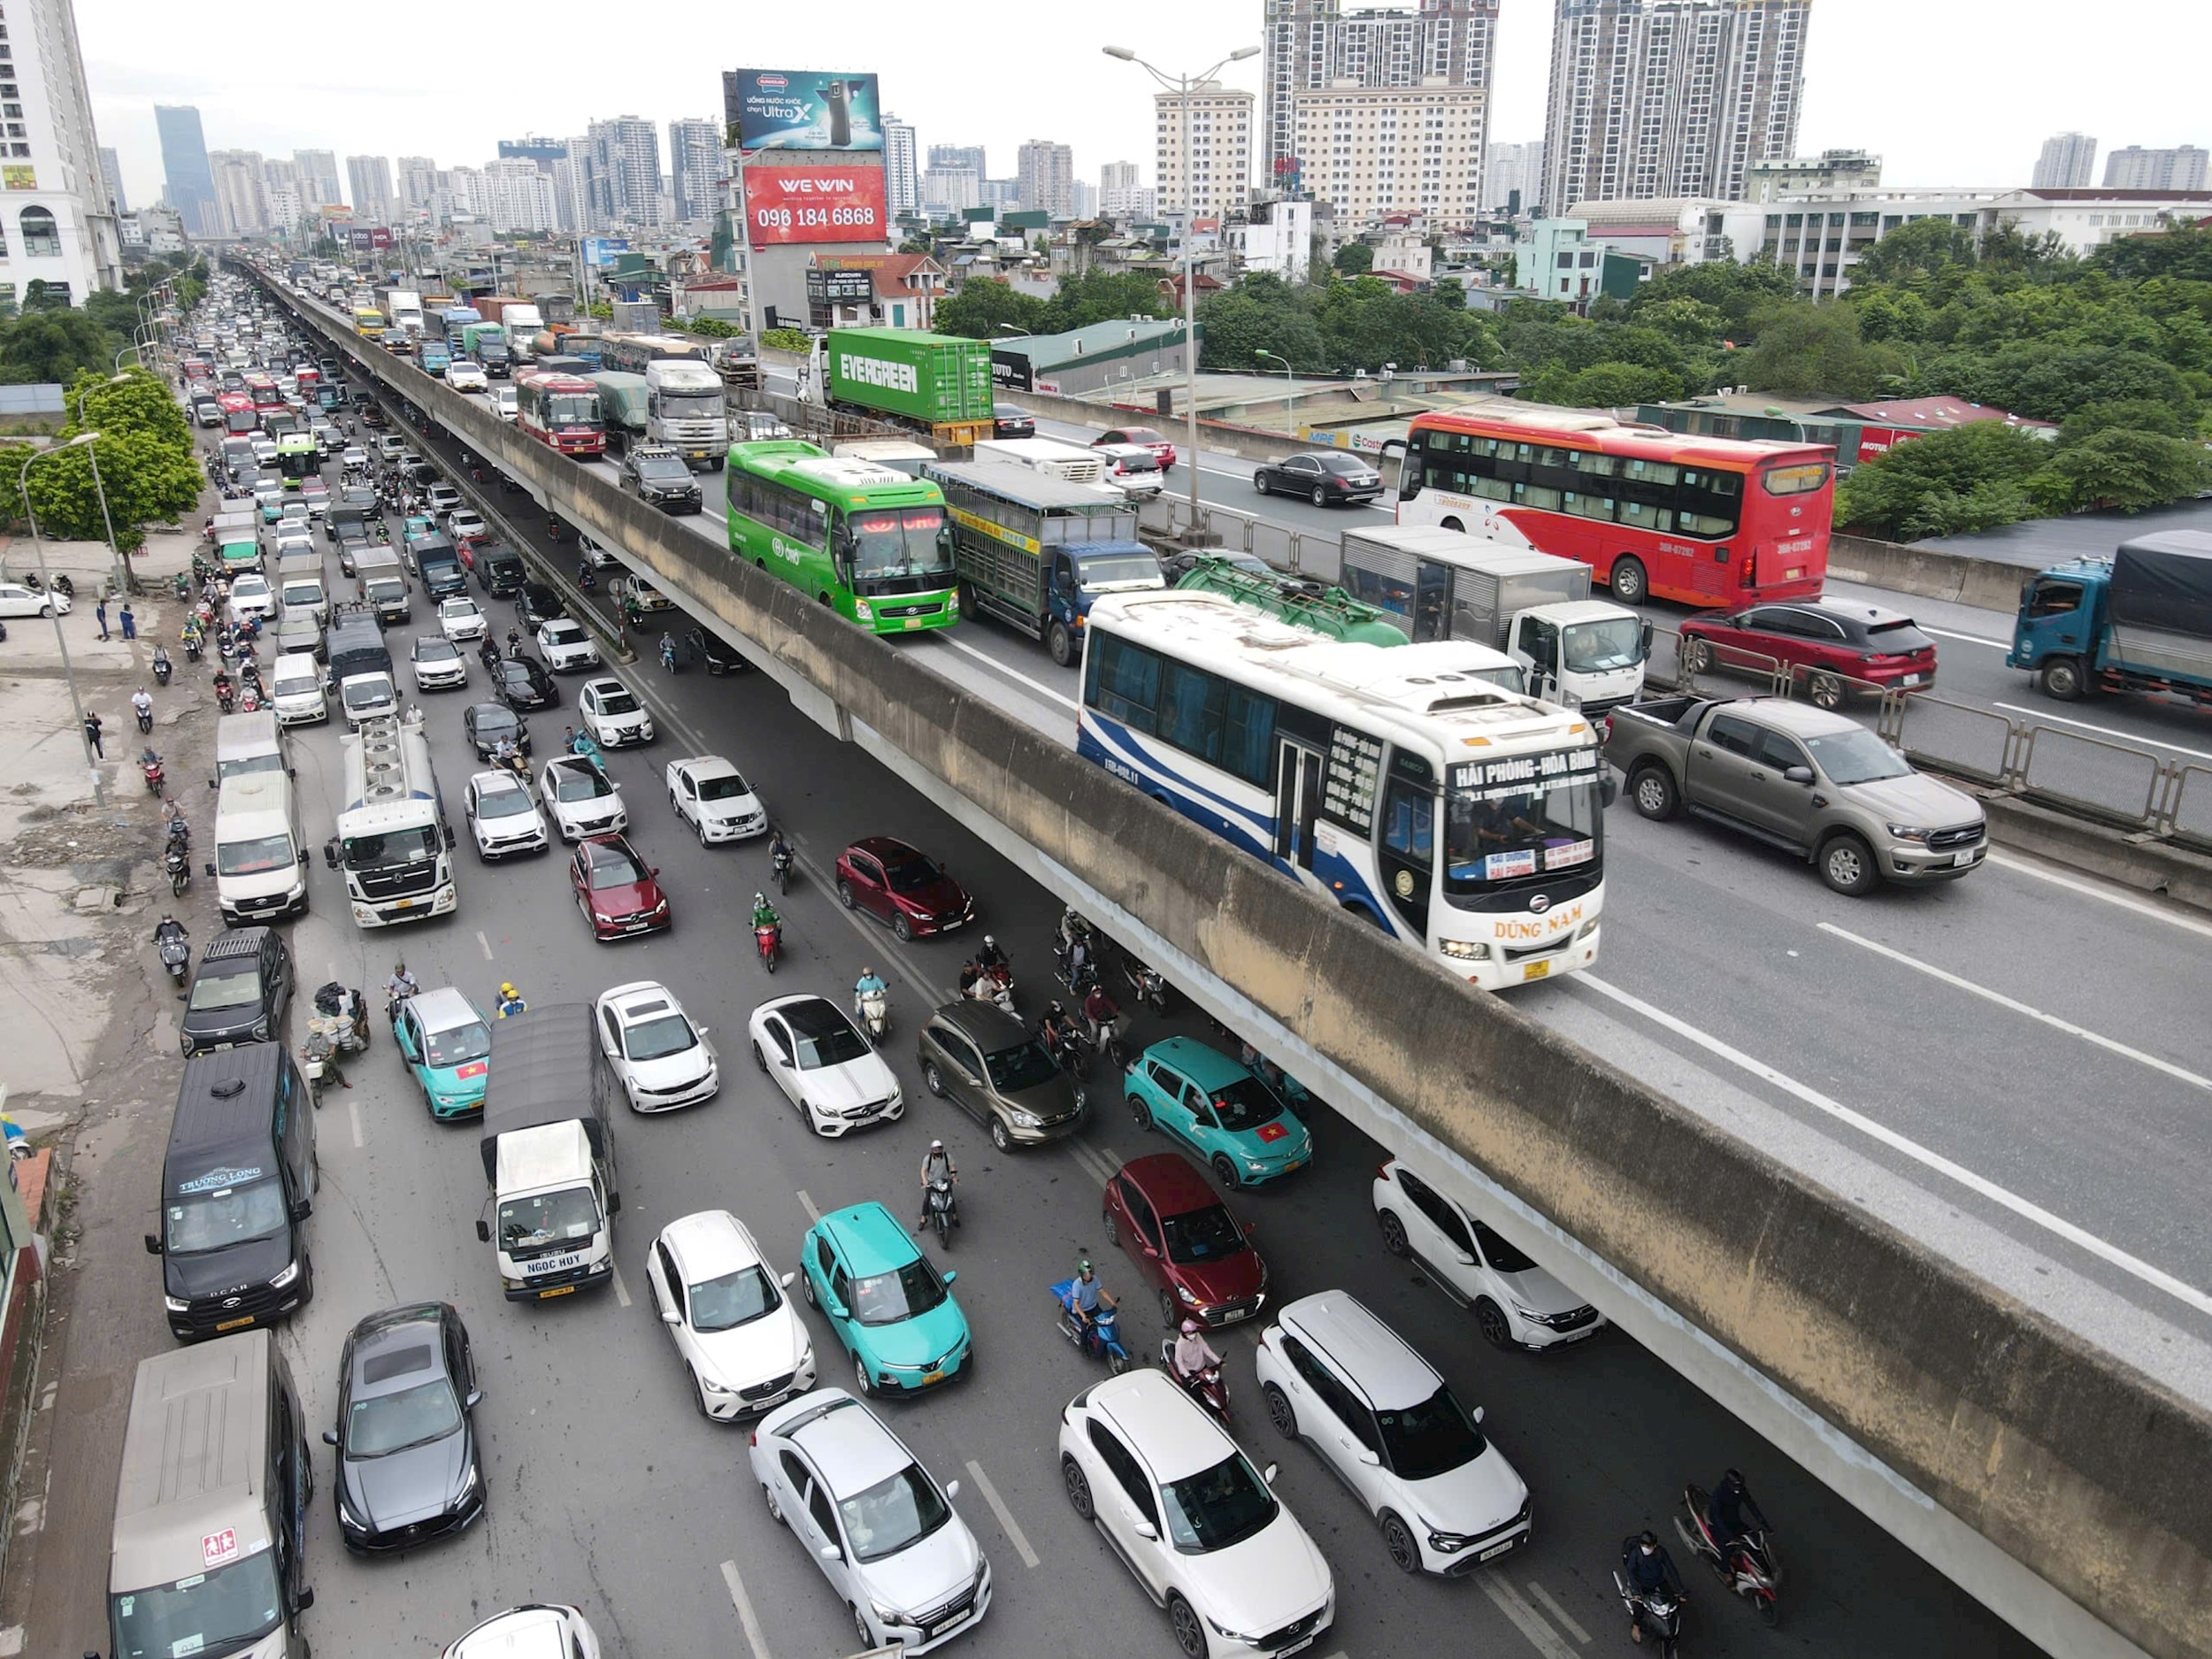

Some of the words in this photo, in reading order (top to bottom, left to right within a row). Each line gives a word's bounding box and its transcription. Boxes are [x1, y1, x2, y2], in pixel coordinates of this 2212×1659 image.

[779, 179, 812, 193] WE
[814, 179, 854, 192] WIN
[758, 209, 792, 227] 096
[796, 208, 828, 226] 184
[833, 207, 874, 226] 6868
[841, 353, 918, 394] EVERGREEN
[1309, 432, 1335, 445] MPE
[1861, 442, 1888, 452] MOTUL
[1455, 762, 1484, 787] HẢI
[1569, 749, 1596, 771] BÌNH
[1494, 919, 1541, 939] DŨNG
[1548, 903, 1582, 933] NAM
[229, 1167, 261, 1179] LONG
[527, 1260, 556, 1273] NGỌC
[559, 1254, 580, 1267] HUY
